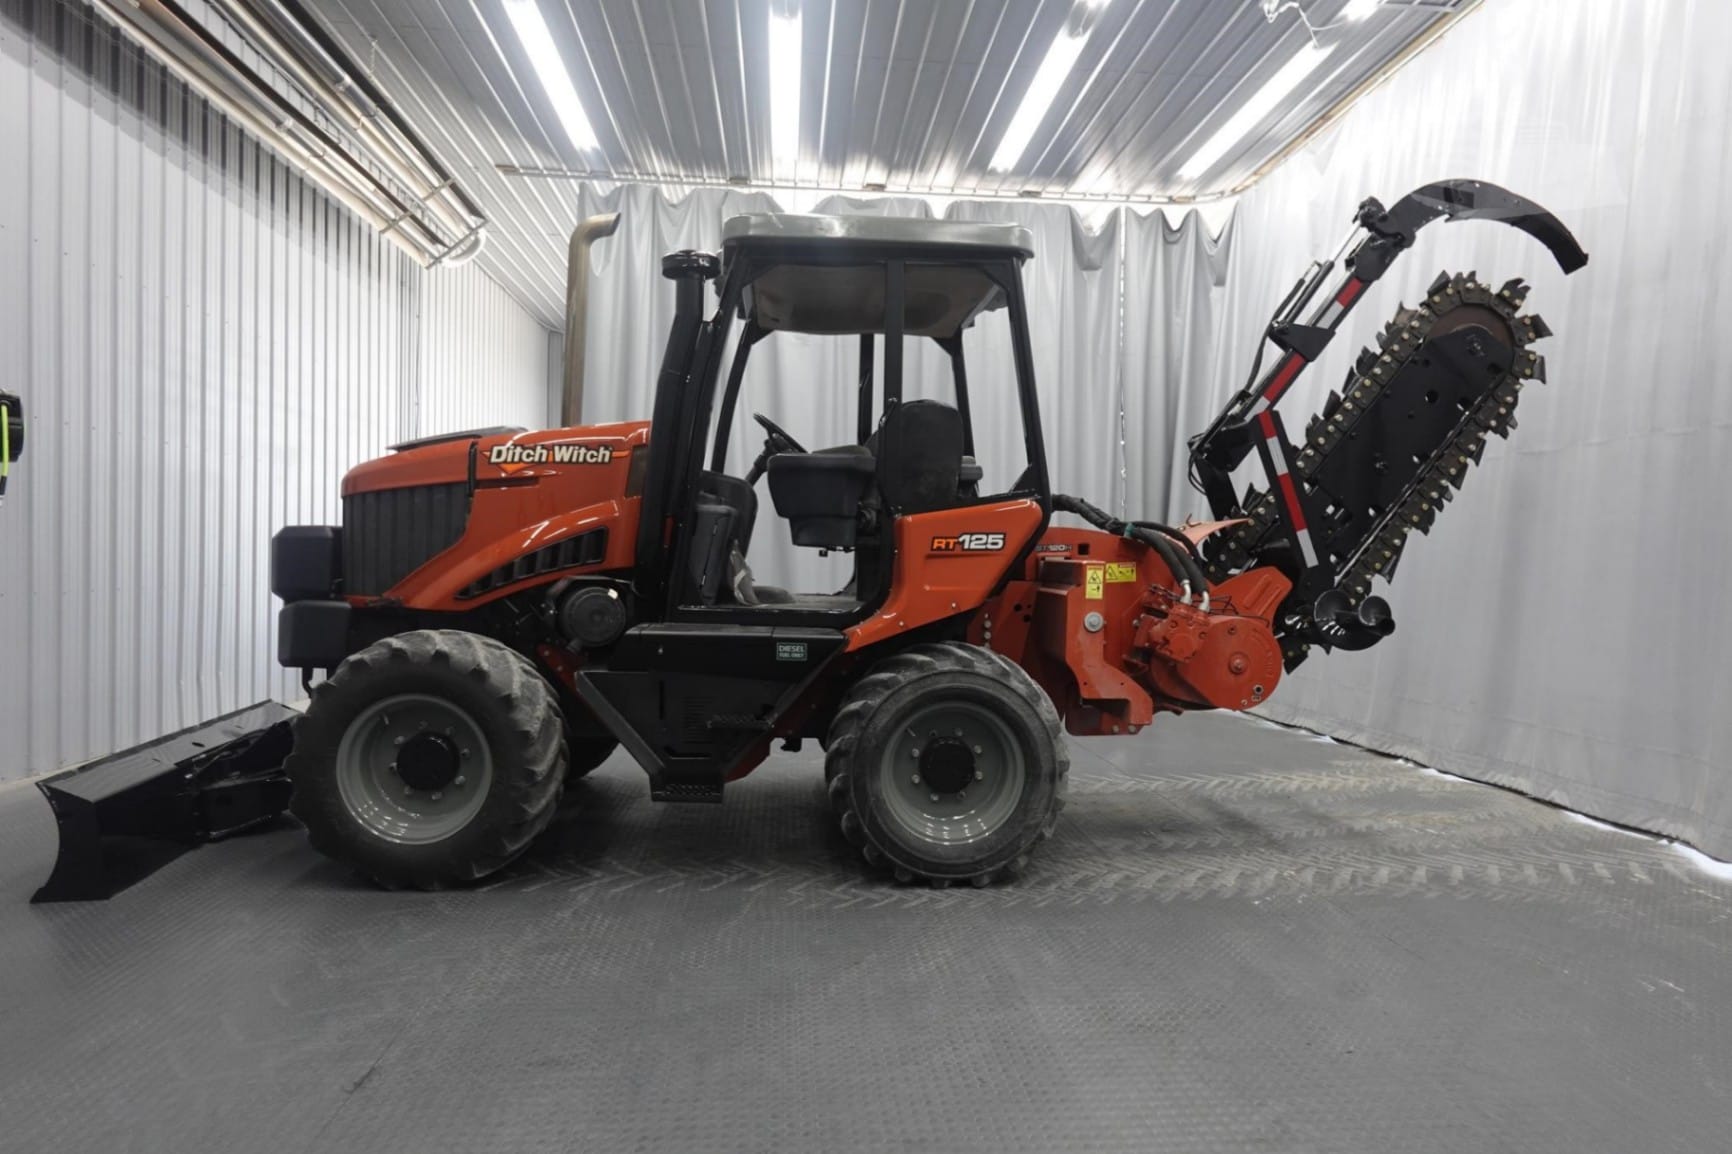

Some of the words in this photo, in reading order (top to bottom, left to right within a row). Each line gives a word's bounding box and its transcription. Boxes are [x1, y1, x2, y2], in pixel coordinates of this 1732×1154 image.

[490, 445, 548, 463] Ditch
[554, 445, 611, 463] Witch
[932, 534, 1005, 550] RT125
[778, 644, 803, 652] DIESEL
